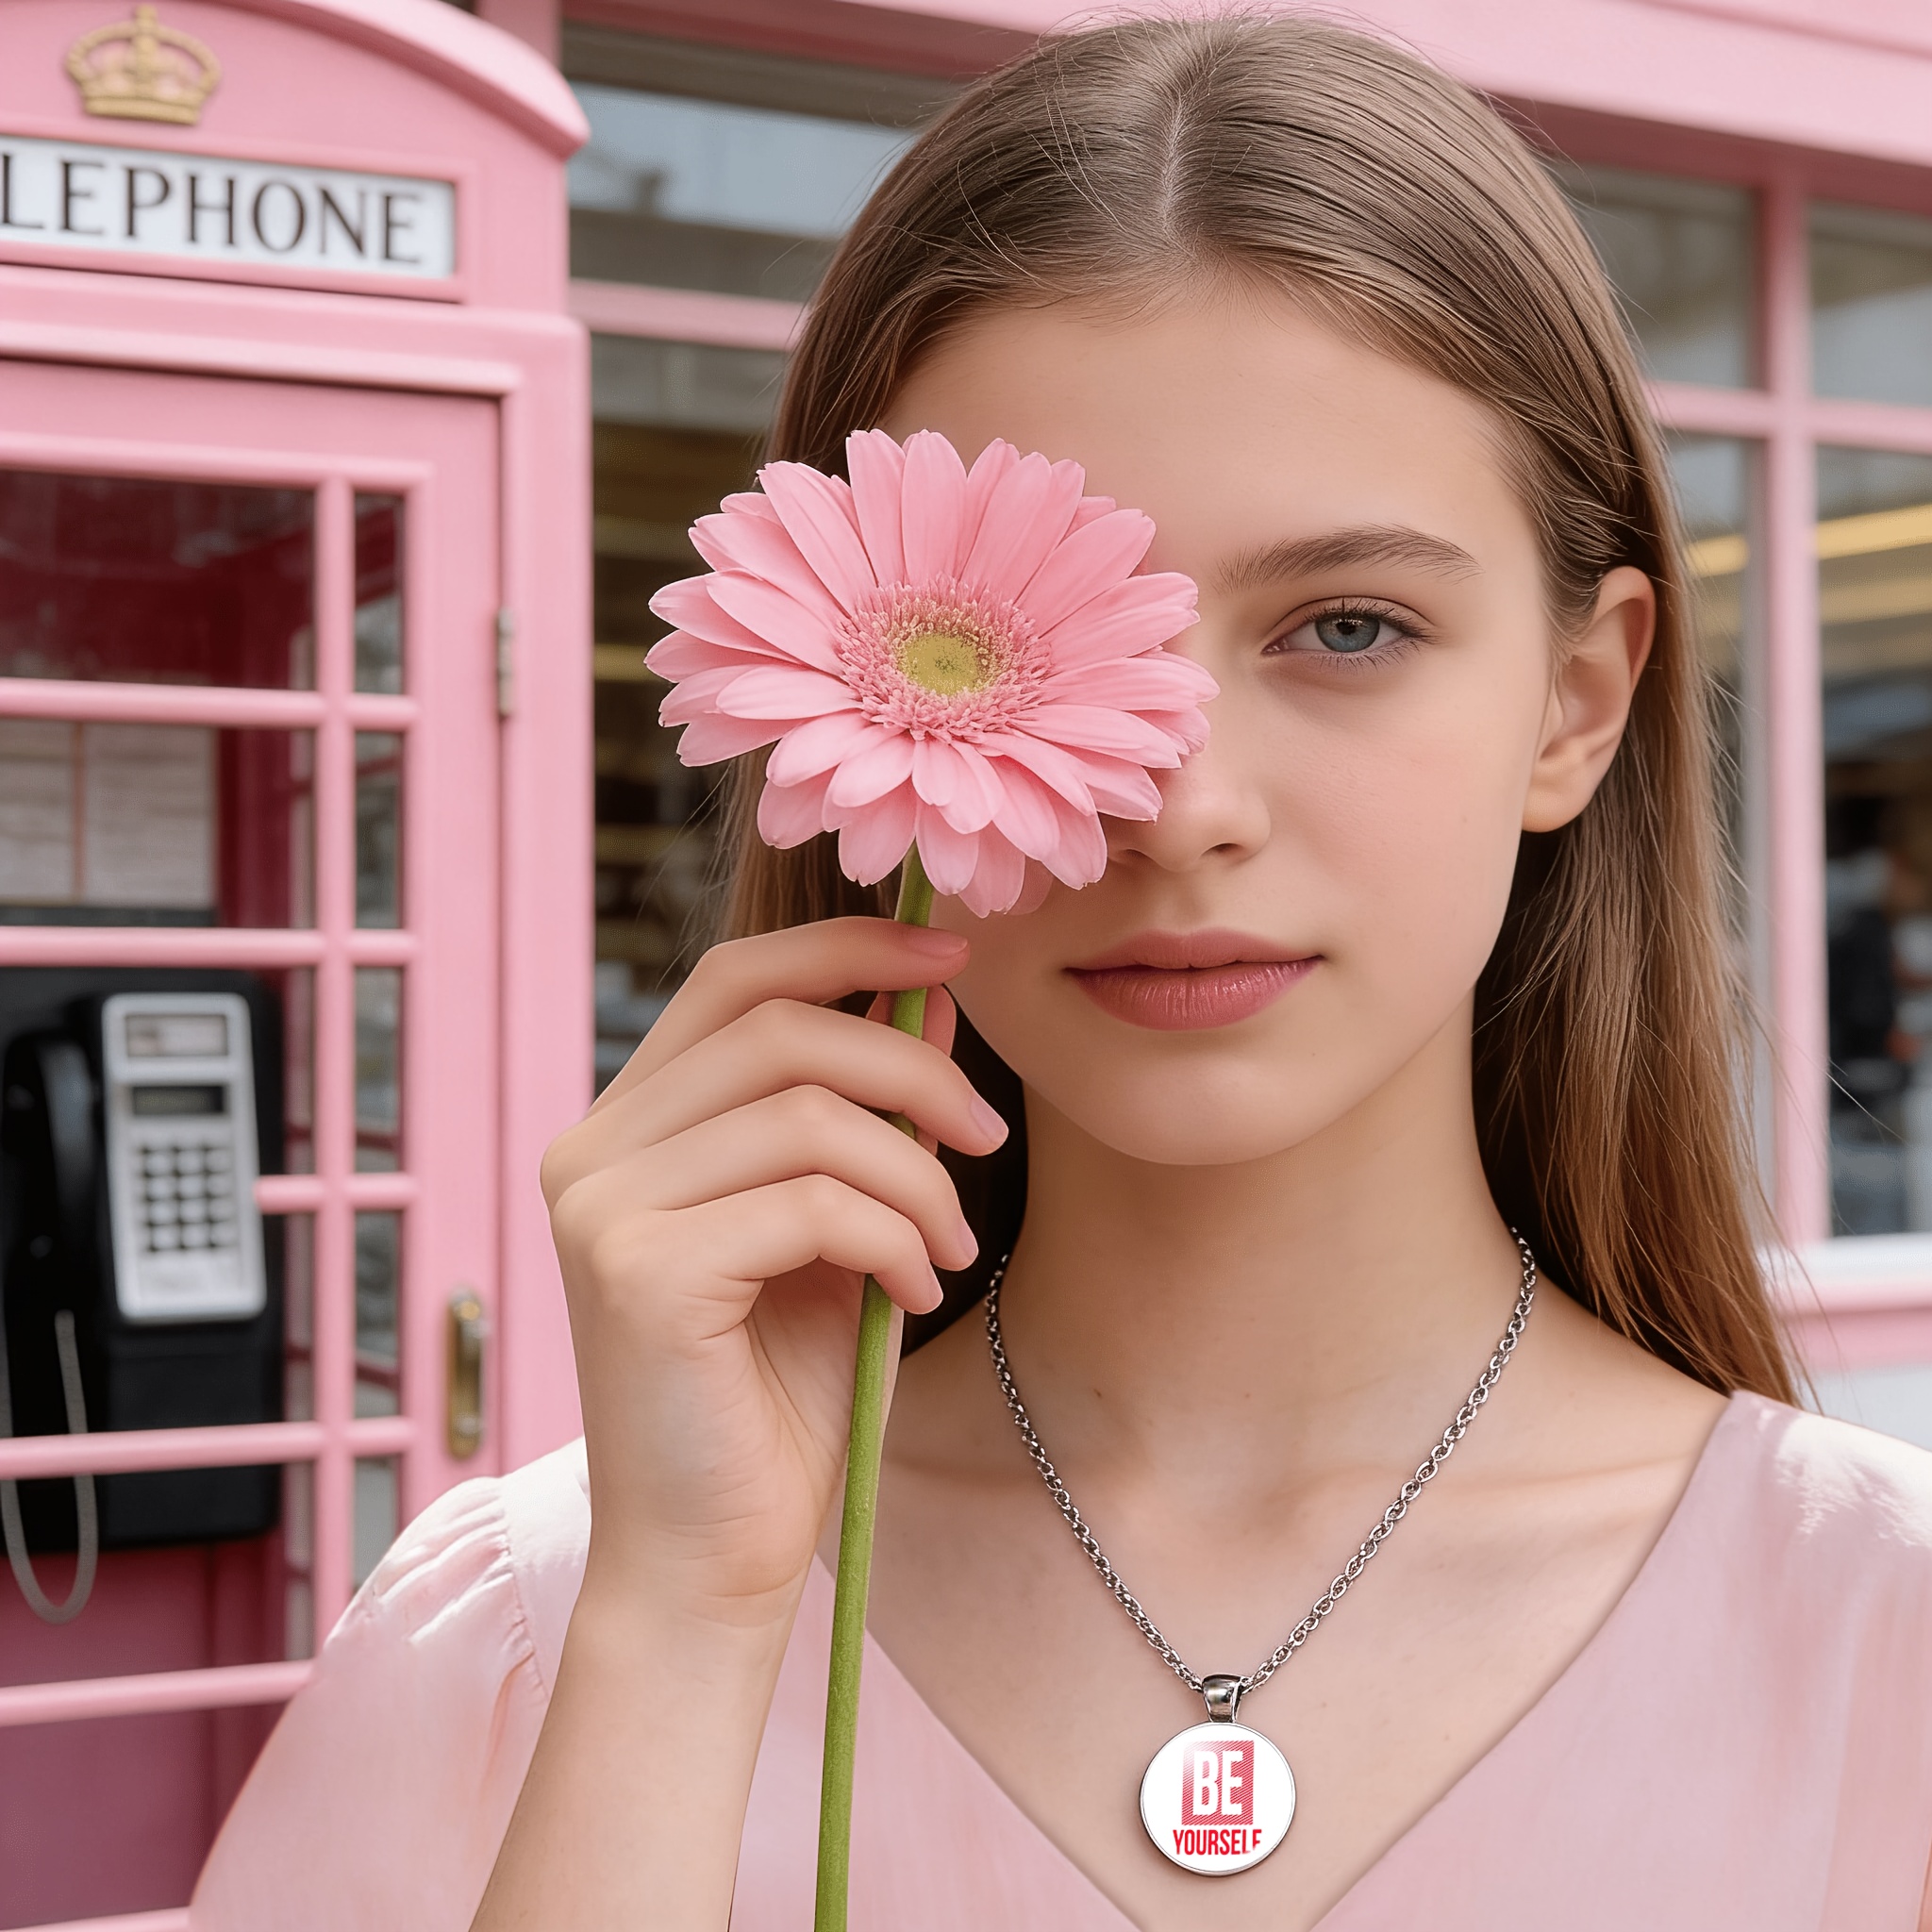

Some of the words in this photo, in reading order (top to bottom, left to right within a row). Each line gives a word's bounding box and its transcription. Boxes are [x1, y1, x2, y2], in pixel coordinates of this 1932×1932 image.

[0, 153, 422, 264] LEPHONE
[1193, 1751, 1243, 1816] BE
[1173, 1829, 1262, 1856] YOURSELF
